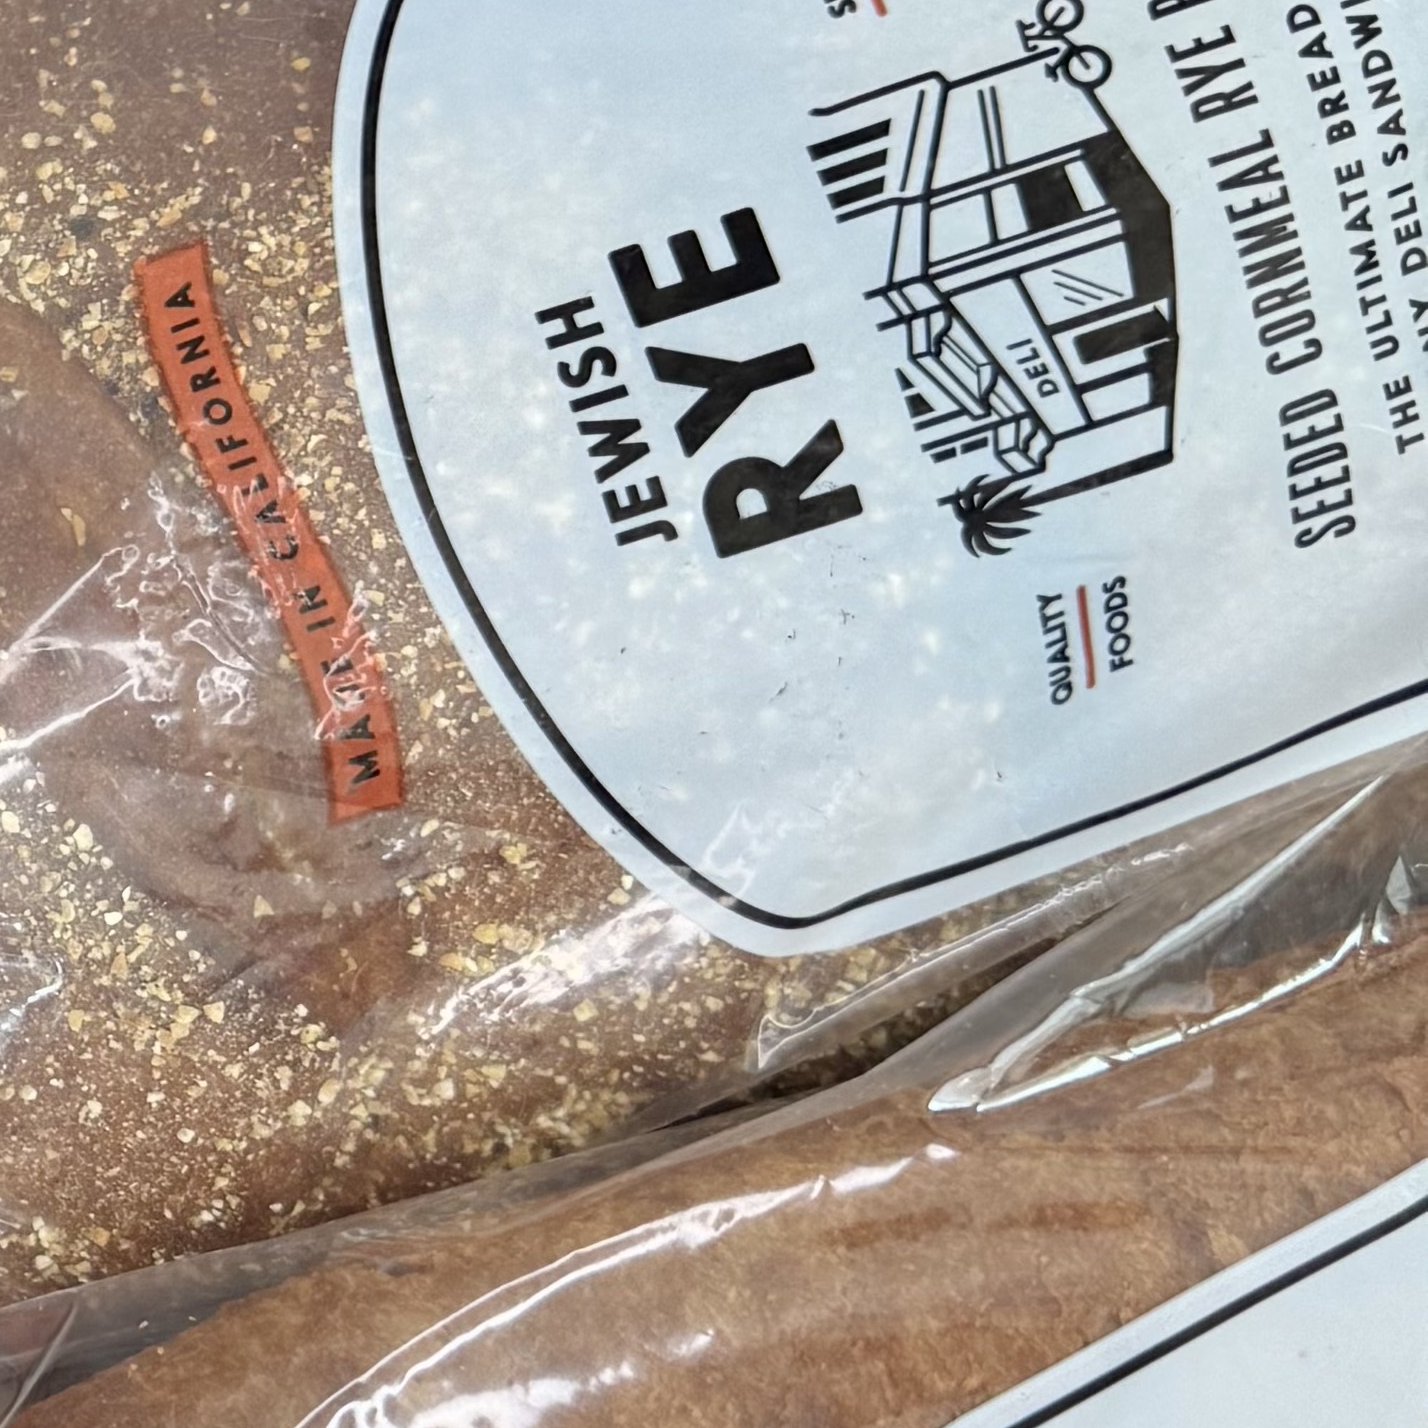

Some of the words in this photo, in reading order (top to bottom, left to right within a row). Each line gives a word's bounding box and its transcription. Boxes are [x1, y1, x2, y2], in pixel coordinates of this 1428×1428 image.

[1164, 24, 1261, 124] RYE
[1286, 2, 1357, 146] BREAD
[1207, 128, 1323, 376] CORNMEAL
[1334, 159, 1400, 361] ULTIMATE
[1387, 181, 1428, 277] DELI
[164, 280, 301, 561] CALIFORNIA
[535, 296, 678, 546] JEWISH
[608, 207, 863, 559] RYE
[1005, 338, 1060, 398] DELI
[1383, 375, 1425, 455] THE
[1279, 388, 1356, 549] SEEDED
[292, 582, 336, 633] IN
[1036, 593, 1073, 706] QUALITY
[1102, 576, 1134, 672] FOODS
